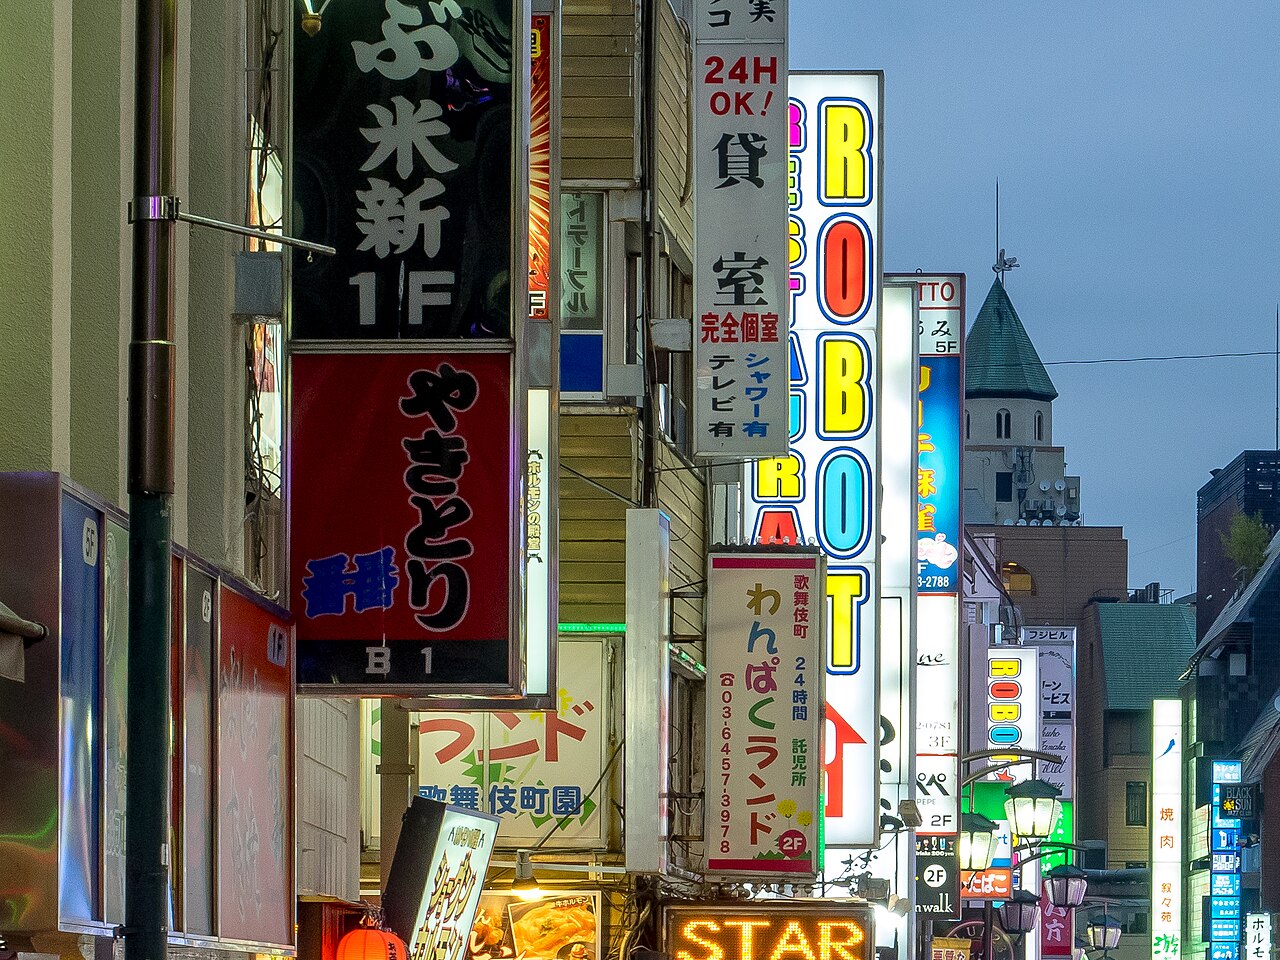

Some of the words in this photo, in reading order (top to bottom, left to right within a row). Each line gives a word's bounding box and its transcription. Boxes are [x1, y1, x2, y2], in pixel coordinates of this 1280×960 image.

[704, 57, 777, 84] 24H
[710, 91, 773, 116] OK!
[349, 271, 455, 325] 1F
[701, 313, 779, 343] 完全個室
[936, 341, 957, 353] 5F
[708, 354, 736, 438] テレビ有
[743, 352, 770, 438] シャワー有
[818, 97, 874, 676] ROBOT
[400, 363, 479, 632] やきとり
[527, 461, 541, 551] ホルモンの殿堂
[793, 574, 810, 639] 歌舞伎町
[1028, 630, 1069, 640] フジビル
[365, 647, 391, 674] B
[791, 657, 808, 721] 24時間
[745, 583, 782, 846] わんぱくランド
[720, 690, 733, 853] 03-6457-3978
[791, 738, 808, 787] 託児所
[1226, 786, 1252, 799] BLACK
[1235, 799, 1252, 811] SUN
[930, 815, 952, 827] 2F
[1159, 807, 1174, 849] 焼肉
[782, 837, 803, 850] 2F
[926, 869, 944, 883] 2F
[1161, 882, 1172, 923] 叙々苑
